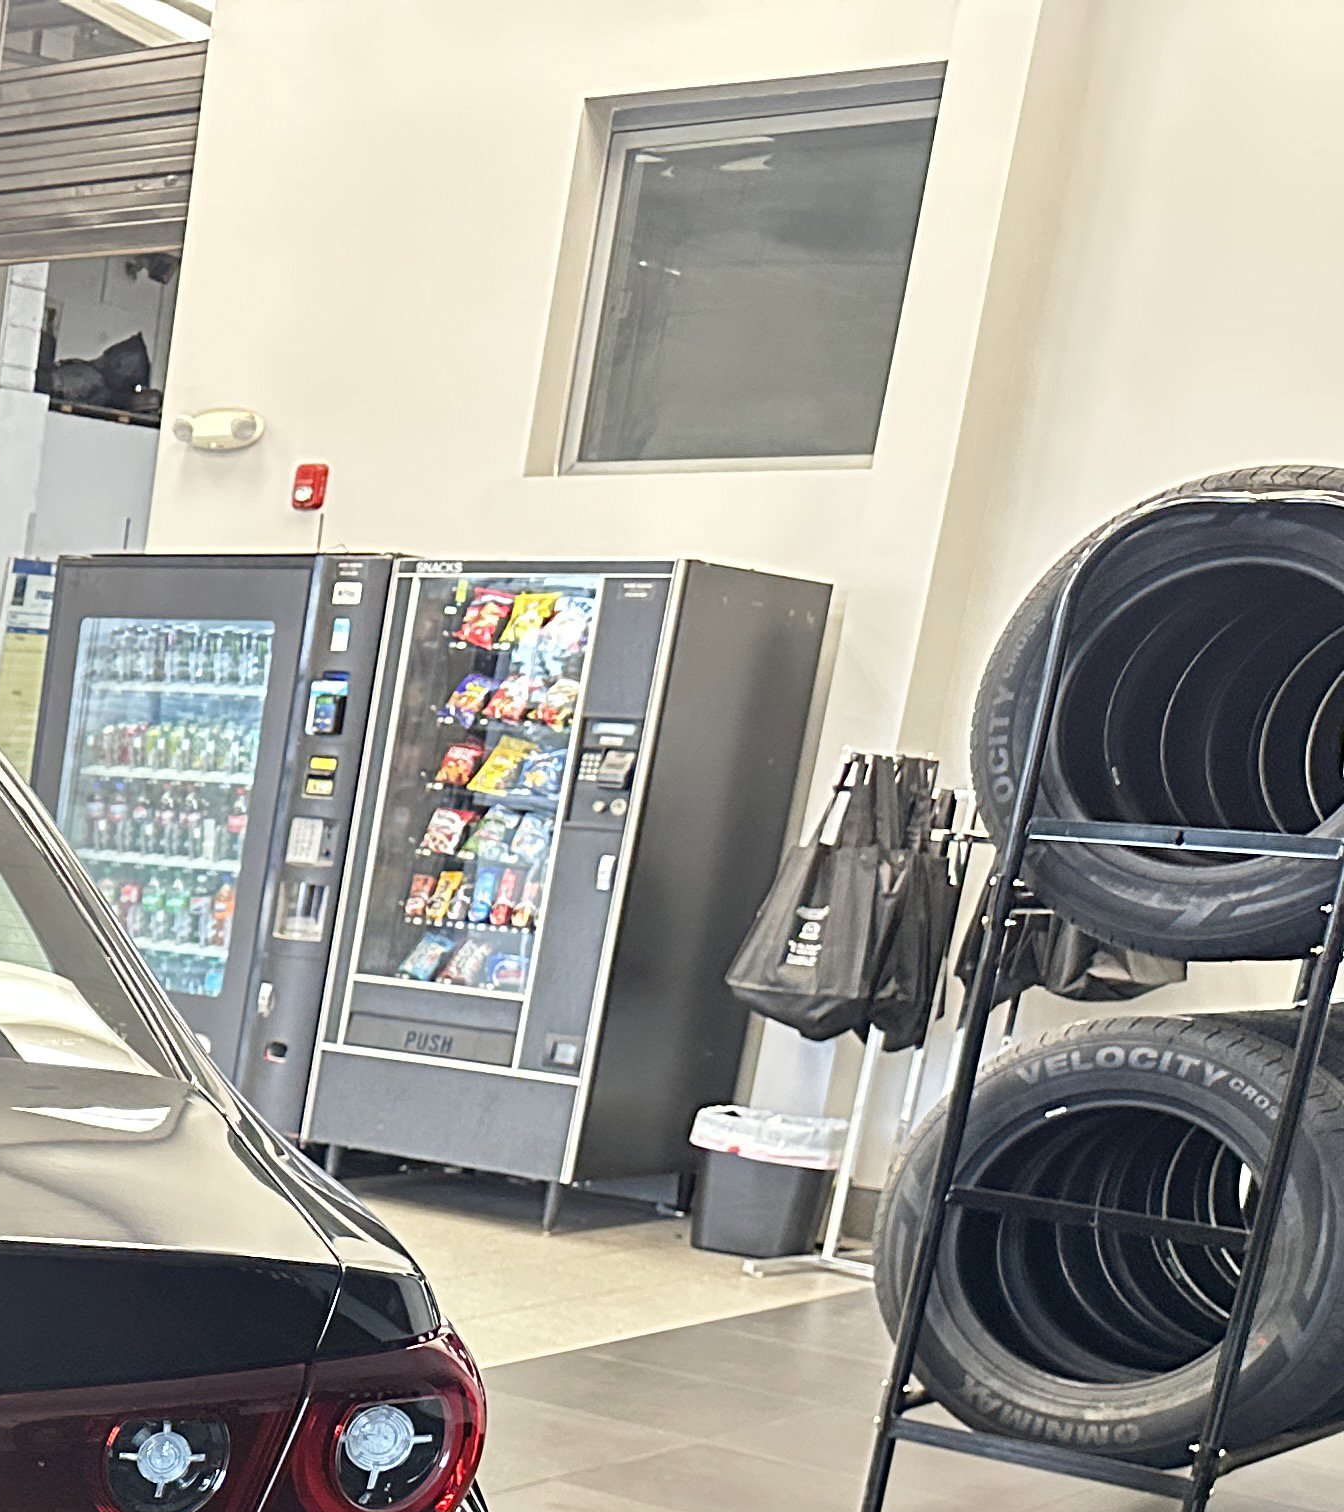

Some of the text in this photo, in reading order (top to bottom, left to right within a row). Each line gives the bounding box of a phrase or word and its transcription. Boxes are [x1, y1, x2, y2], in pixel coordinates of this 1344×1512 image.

[416, 561, 464, 574] SNACKS
[988, 685, 1016, 805] OCITY
[404, 1030, 455, 1054] PUSH
[1015, 1045, 1281, 1121] VELOCITY CROS
